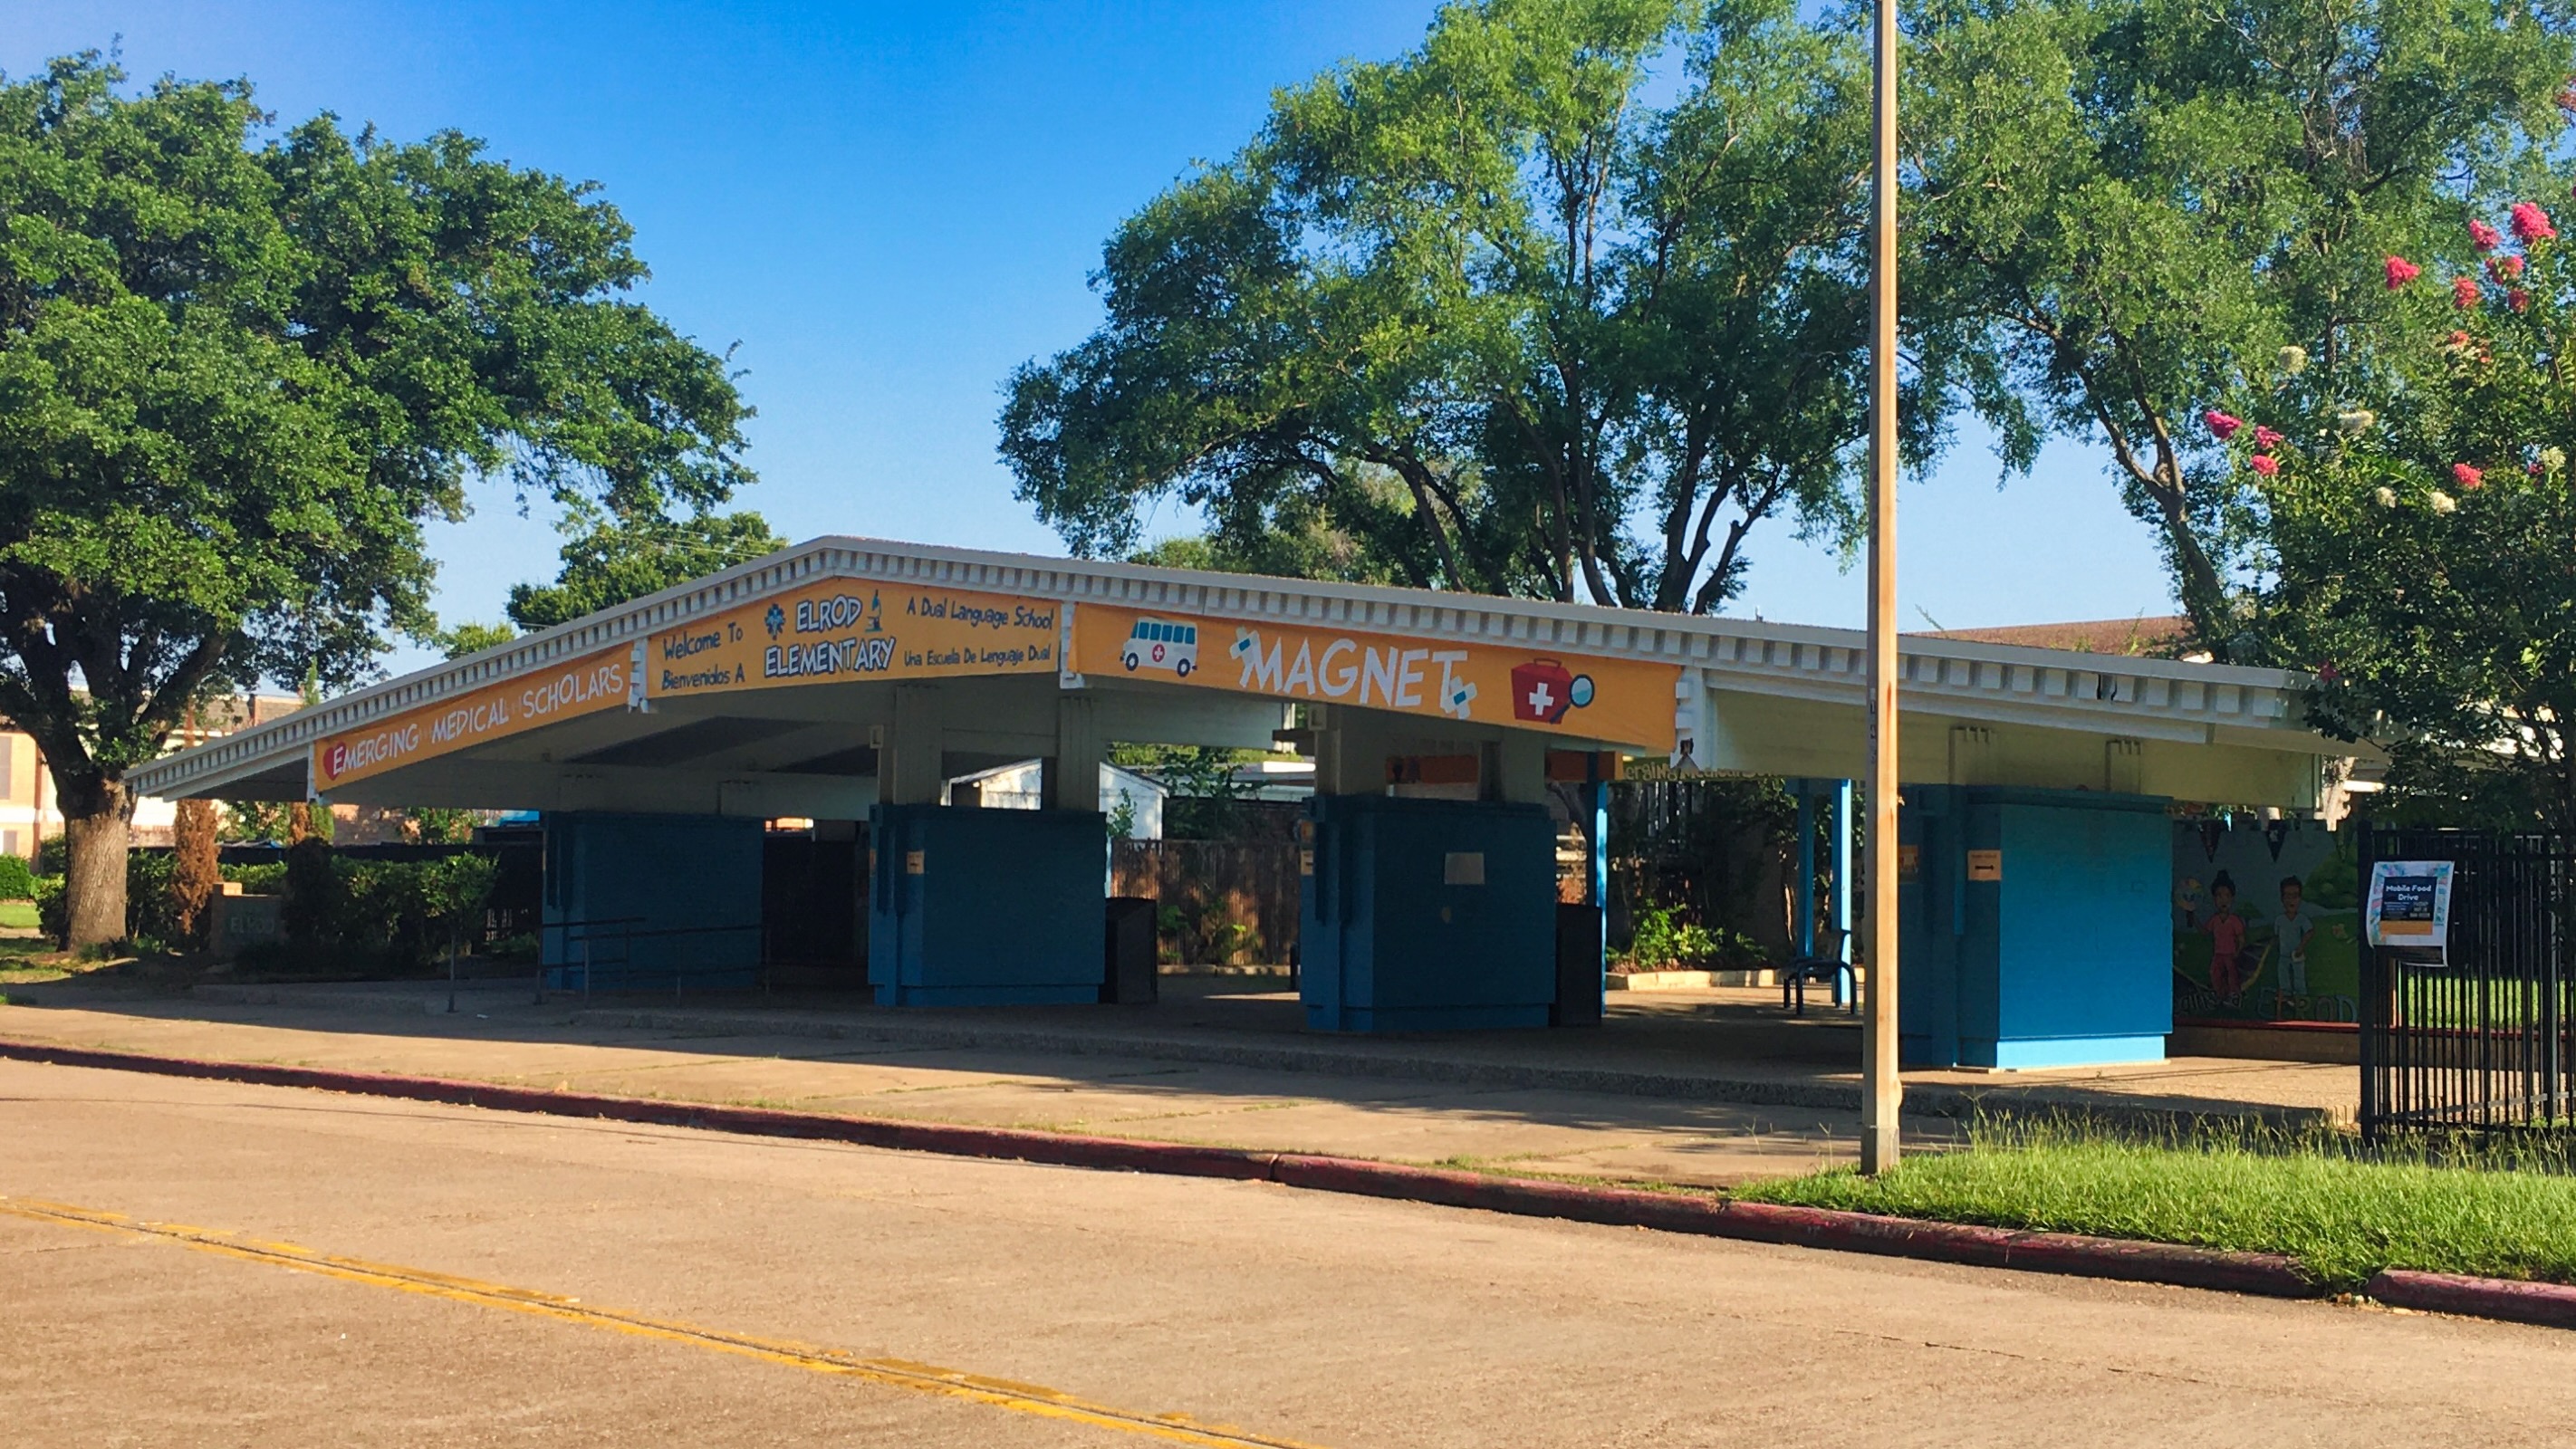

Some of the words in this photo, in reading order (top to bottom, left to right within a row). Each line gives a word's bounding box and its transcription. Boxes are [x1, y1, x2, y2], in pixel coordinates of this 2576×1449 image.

[795, 594, 862, 633] ELROD
[907, 596, 916, 615] A
[920, 597, 947, 619] Dual
[951, 600, 1009, 629] Language
[1014, 605, 1054, 630] School
[663, 629, 721, 660] Welcome
[728, 621, 744, 643] To
[764, 636, 896, 678] ELEMENTARY
[904, 650, 922, 667] Una
[927, 648, 960, 666] Escuela
[964, 647, 976, 663] De
[981, 647, 1024, 667] Lenguaje
[1028, 644, 1051, 662] Dual
[661, 664, 730, 690] Bienvenidos
[735, 663, 745, 683] A
[1237, 629, 1469, 714] MAGNET
[332, 723, 419, 775] EMERGING
[431, 697, 509, 744] MEDICAL
[522, 663, 624, 719] SCHOLARS
[2386, 884, 2410, 892] Mobile
[2411, 884, 2432, 892] Food
[2398, 893, 2418, 901] Drive
